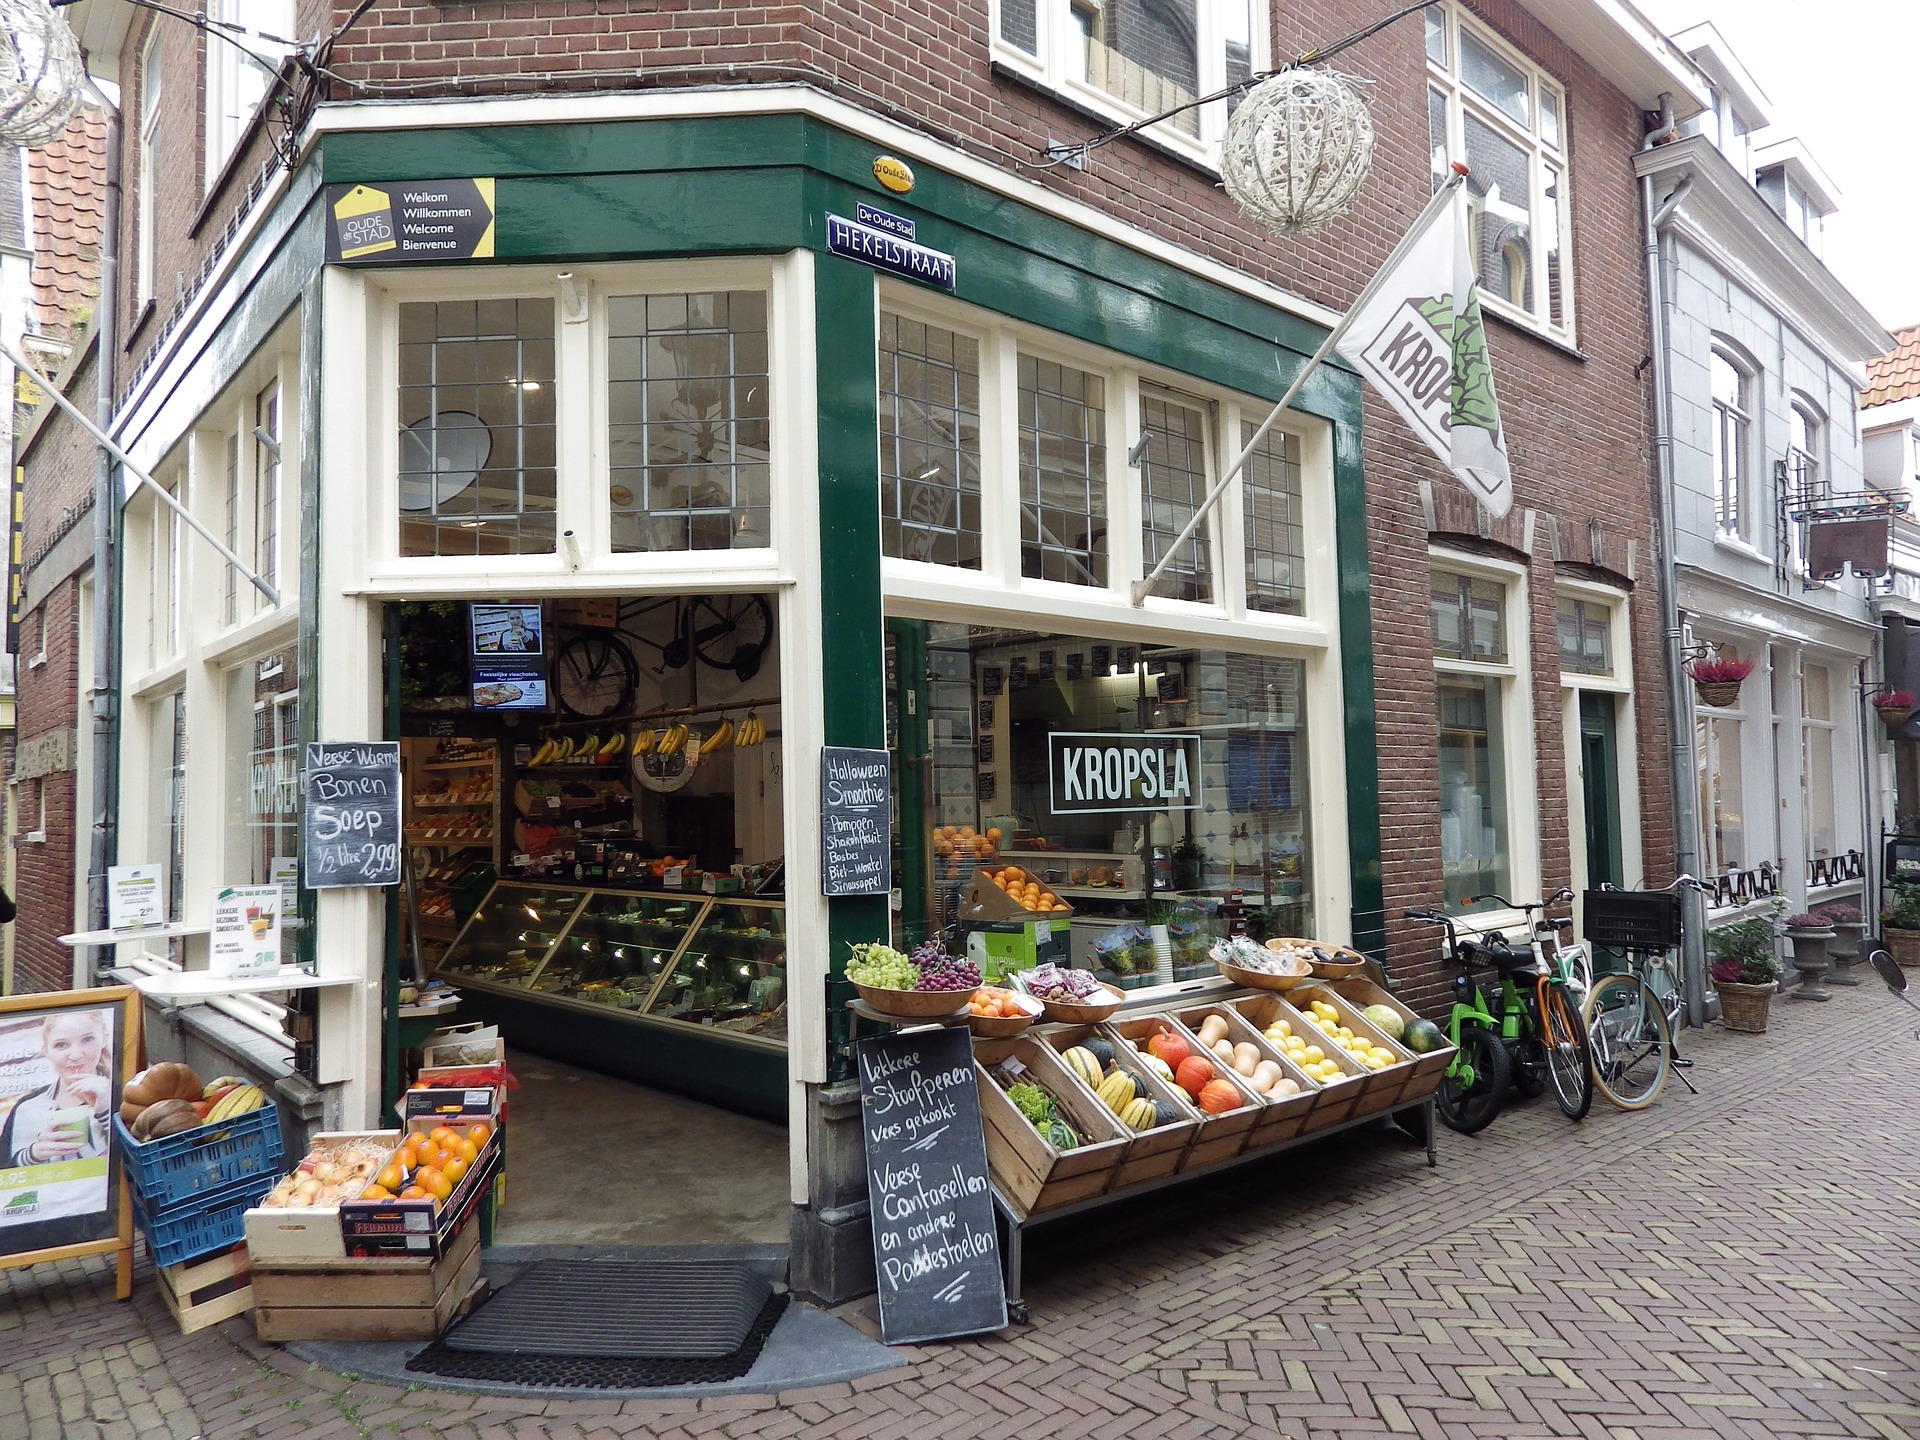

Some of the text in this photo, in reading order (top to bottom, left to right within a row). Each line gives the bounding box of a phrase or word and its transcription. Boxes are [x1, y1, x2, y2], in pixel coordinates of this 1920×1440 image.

[403, 192, 448, 203] Welkom
[347, 215, 383, 232] OUDE
[403, 208, 471, 219] Willkommen
[860, 209, 913, 236] De Oude Stad
[343, 225, 391, 244] de STAD
[403, 224, 454, 235] Welcome
[403, 239, 457, 251] Bienvenue
[836, 223, 951, 281] HEKELSTRAAT
[309, 745, 353, 767] Verse
[828, 757, 887, 781] Halloween
[1063, 747, 1191, 801] KROPSLA
[250, 759, 298, 814] KROPSLA
[311, 773, 387, 801] Bonen
[827, 781, 885, 806] Smoothie
[314, 806, 383, 840] Soep
[830, 815, 874, 836] Pompoen
[829, 848, 859, 864] Bosbes
[216, 907, 239, 915] LEKKERE
[216, 916, 239, 924] GEZONDE
[216, 924, 245, 932] SMOOTHIES
[872, 1066, 973, 1114] Stoofperen
[906, 1094, 957, 1140] gekookt
[873, 1161, 922, 1194] Verse
[882, 1163, 988, 1221] Cantarellen
[6, 1205, 37, 1216] KROPSLA
[881, 1210, 956, 1251] en andere
[882, 1222, 995, 1291] Paddestoelen
